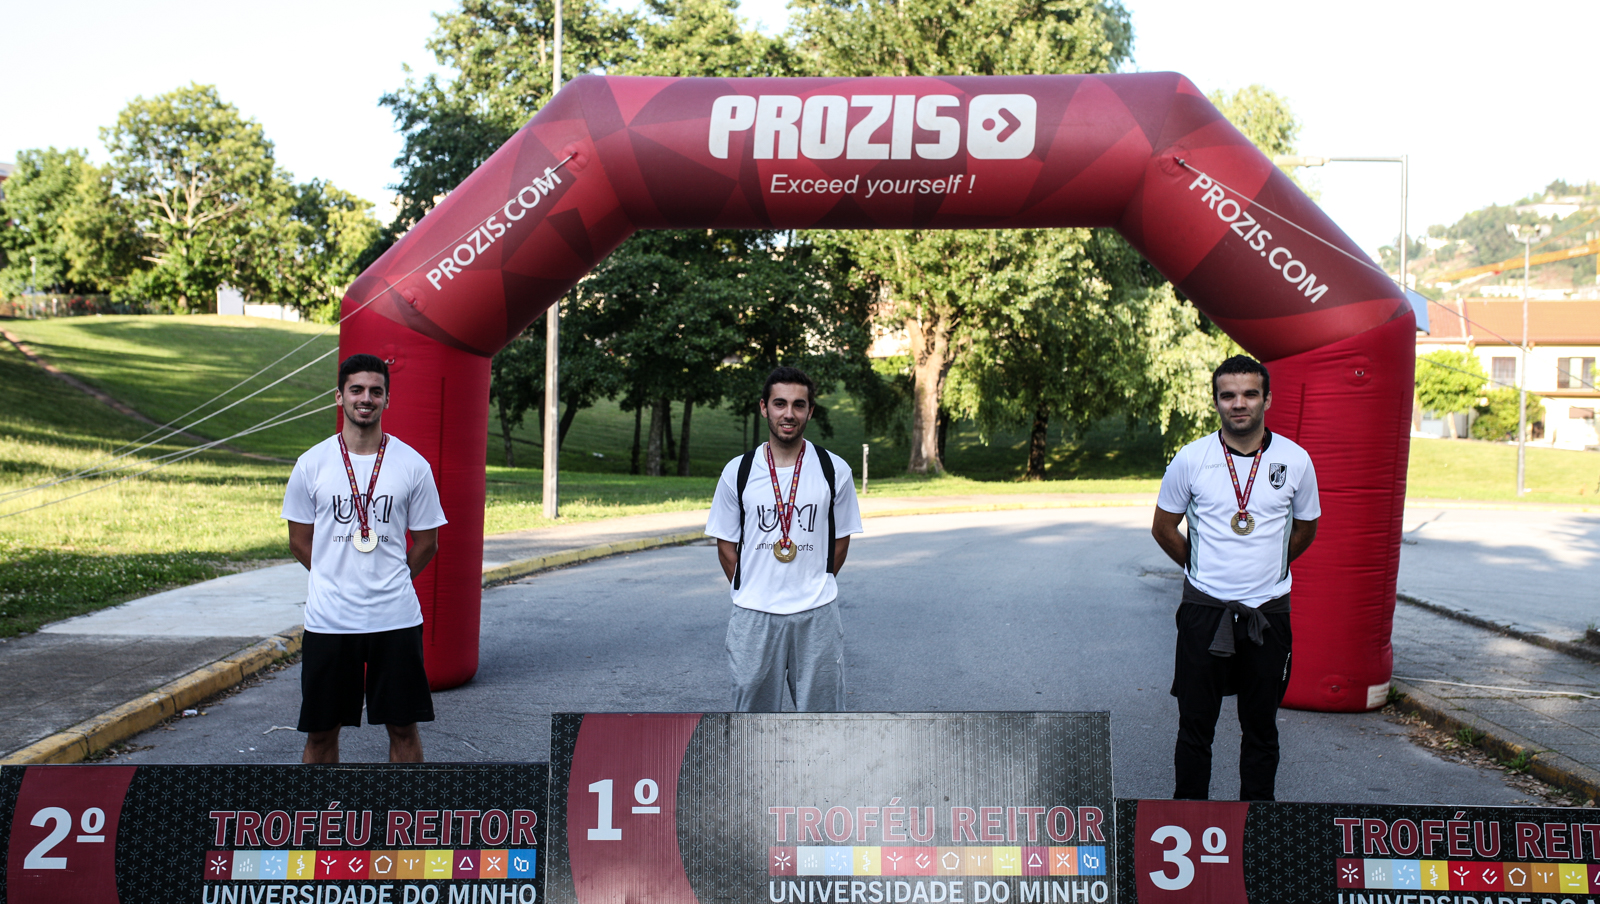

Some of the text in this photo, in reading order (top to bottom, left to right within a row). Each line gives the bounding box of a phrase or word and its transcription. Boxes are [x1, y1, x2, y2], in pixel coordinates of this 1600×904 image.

[709, 94, 960, 159] PROZIS
[770, 174, 859, 194] Exceed
[865, 174, 963, 198] yourself
[426, 167, 562, 291] PROZIS.COM
[1189, 173, 1329, 303] PROZIS.COM
[209, 801, 537, 847] TROFÉU REITOR
[586, 778, 661, 841] 1º
[768, 797, 1104, 842] TROFÉU REITOR
[1333, 811, 1501, 857] TROFÉU
[22, 807, 106, 870] 2º
[1149, 825, 1230, 891] 3º
[202, 884, 537, 904] UNIVERSIDADE DO MINHO
[769, 881, 1109, 903] UNIVERSIDADE DO MINHO
